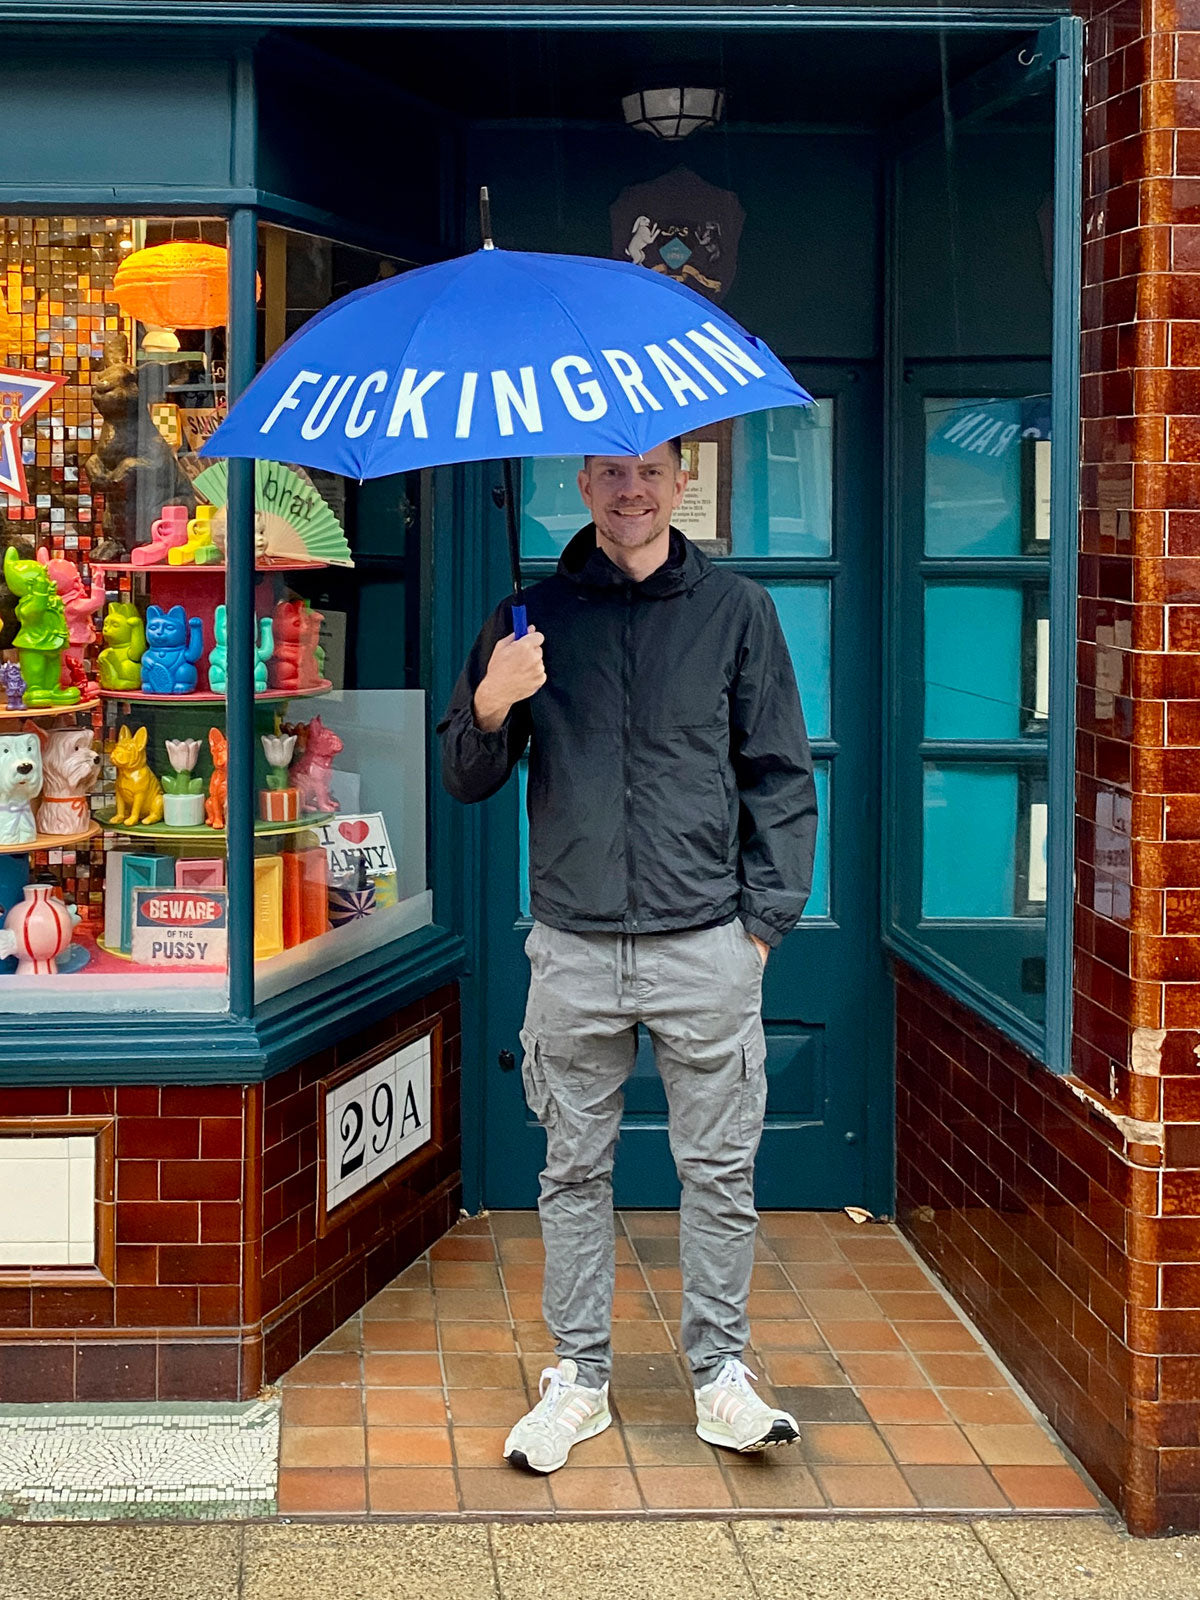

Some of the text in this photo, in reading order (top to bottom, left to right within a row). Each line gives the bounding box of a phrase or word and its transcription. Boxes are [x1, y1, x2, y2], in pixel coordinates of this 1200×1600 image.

[263, 470, 315, 522] brat
[318, 824, 336, 846] I
[330, 845, 389, 872] ANNY
[149, 899, 215, 919] BEWARE
[166, 930, 193, 939] OF THE
[151, 941, 208, 959] PUSSY
[340, 1079, 422, 1180] 29A
